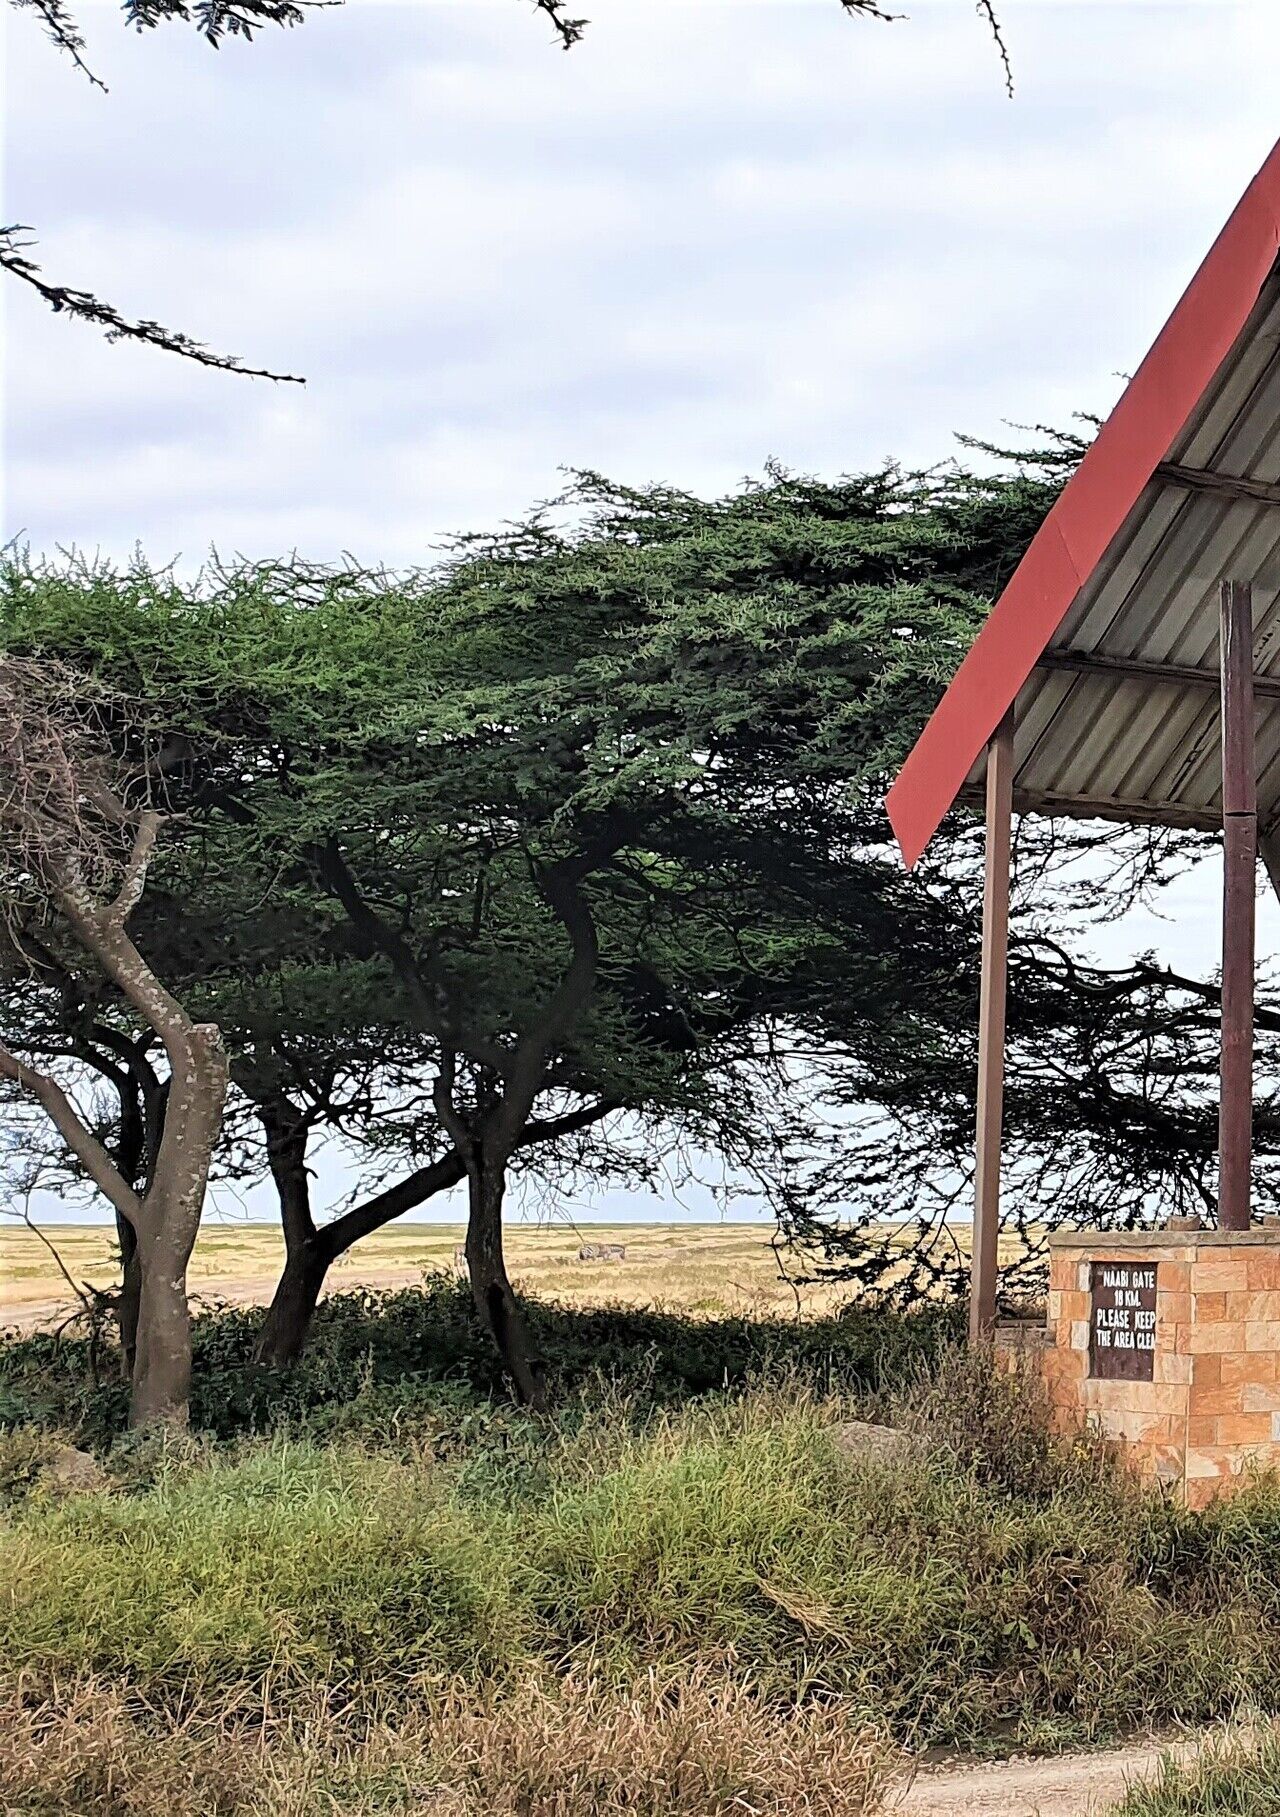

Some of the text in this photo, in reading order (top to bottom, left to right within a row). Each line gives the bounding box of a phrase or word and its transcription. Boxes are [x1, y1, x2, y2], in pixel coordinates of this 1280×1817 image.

[1103, 1270, 1155, 1288] NAABI GATE
[1114, 1290, 1141, 1307] 18 KM.
[1097, 1309, 1156, 1330] PLEASE KEEP
[1096, 1329, 1156, 1350] THE AREA CLEA
